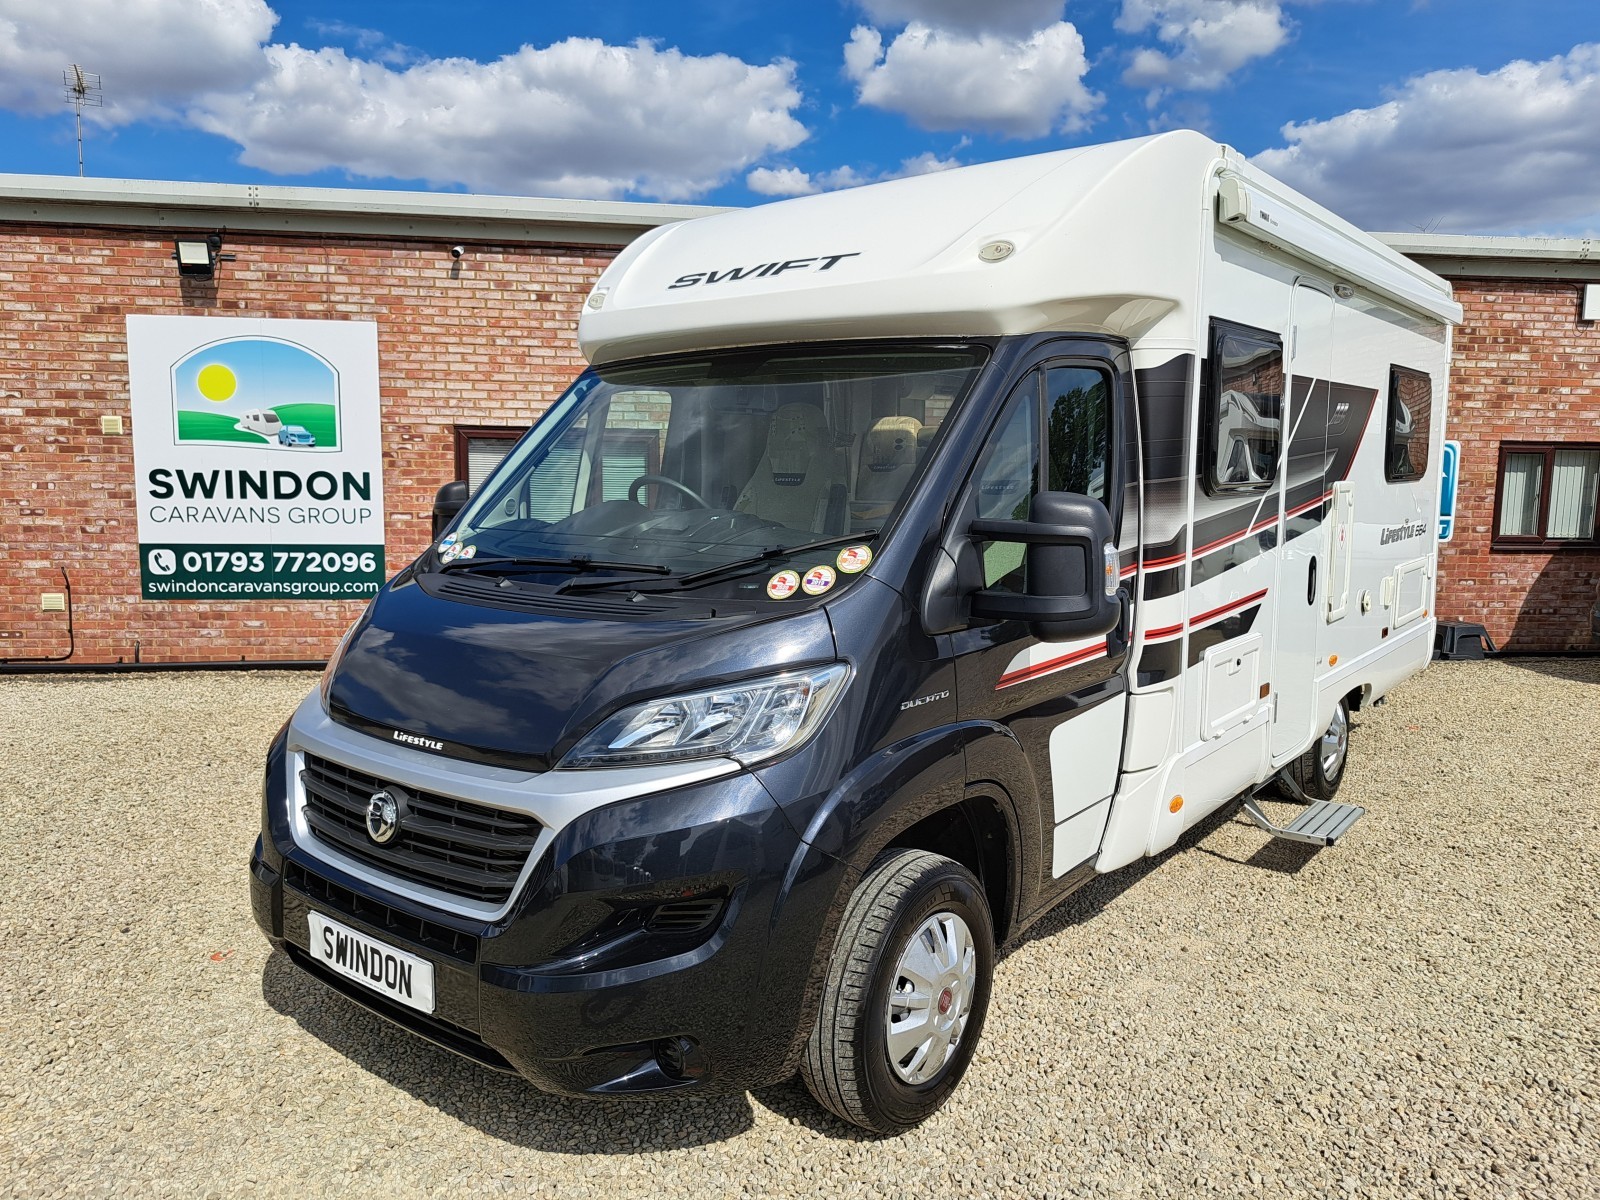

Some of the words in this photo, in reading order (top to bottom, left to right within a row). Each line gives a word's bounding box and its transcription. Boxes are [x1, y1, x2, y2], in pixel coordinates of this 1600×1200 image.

[667, 252, 861, 289] SWIFT
[148, 468, 371, 501] SWINDON
[149, 505, 281, 524] CARAVANS
[288, 507, 372, 524] GROUP
[182, 552, 265, 573] 01793
[273, 552, 376, 573] 772096
[148, 578, 379, 595] swindoncaravansgroup.com
[900, 689, 950, 711] DUCATO
[323, 925, 413, 999] SWINDON
